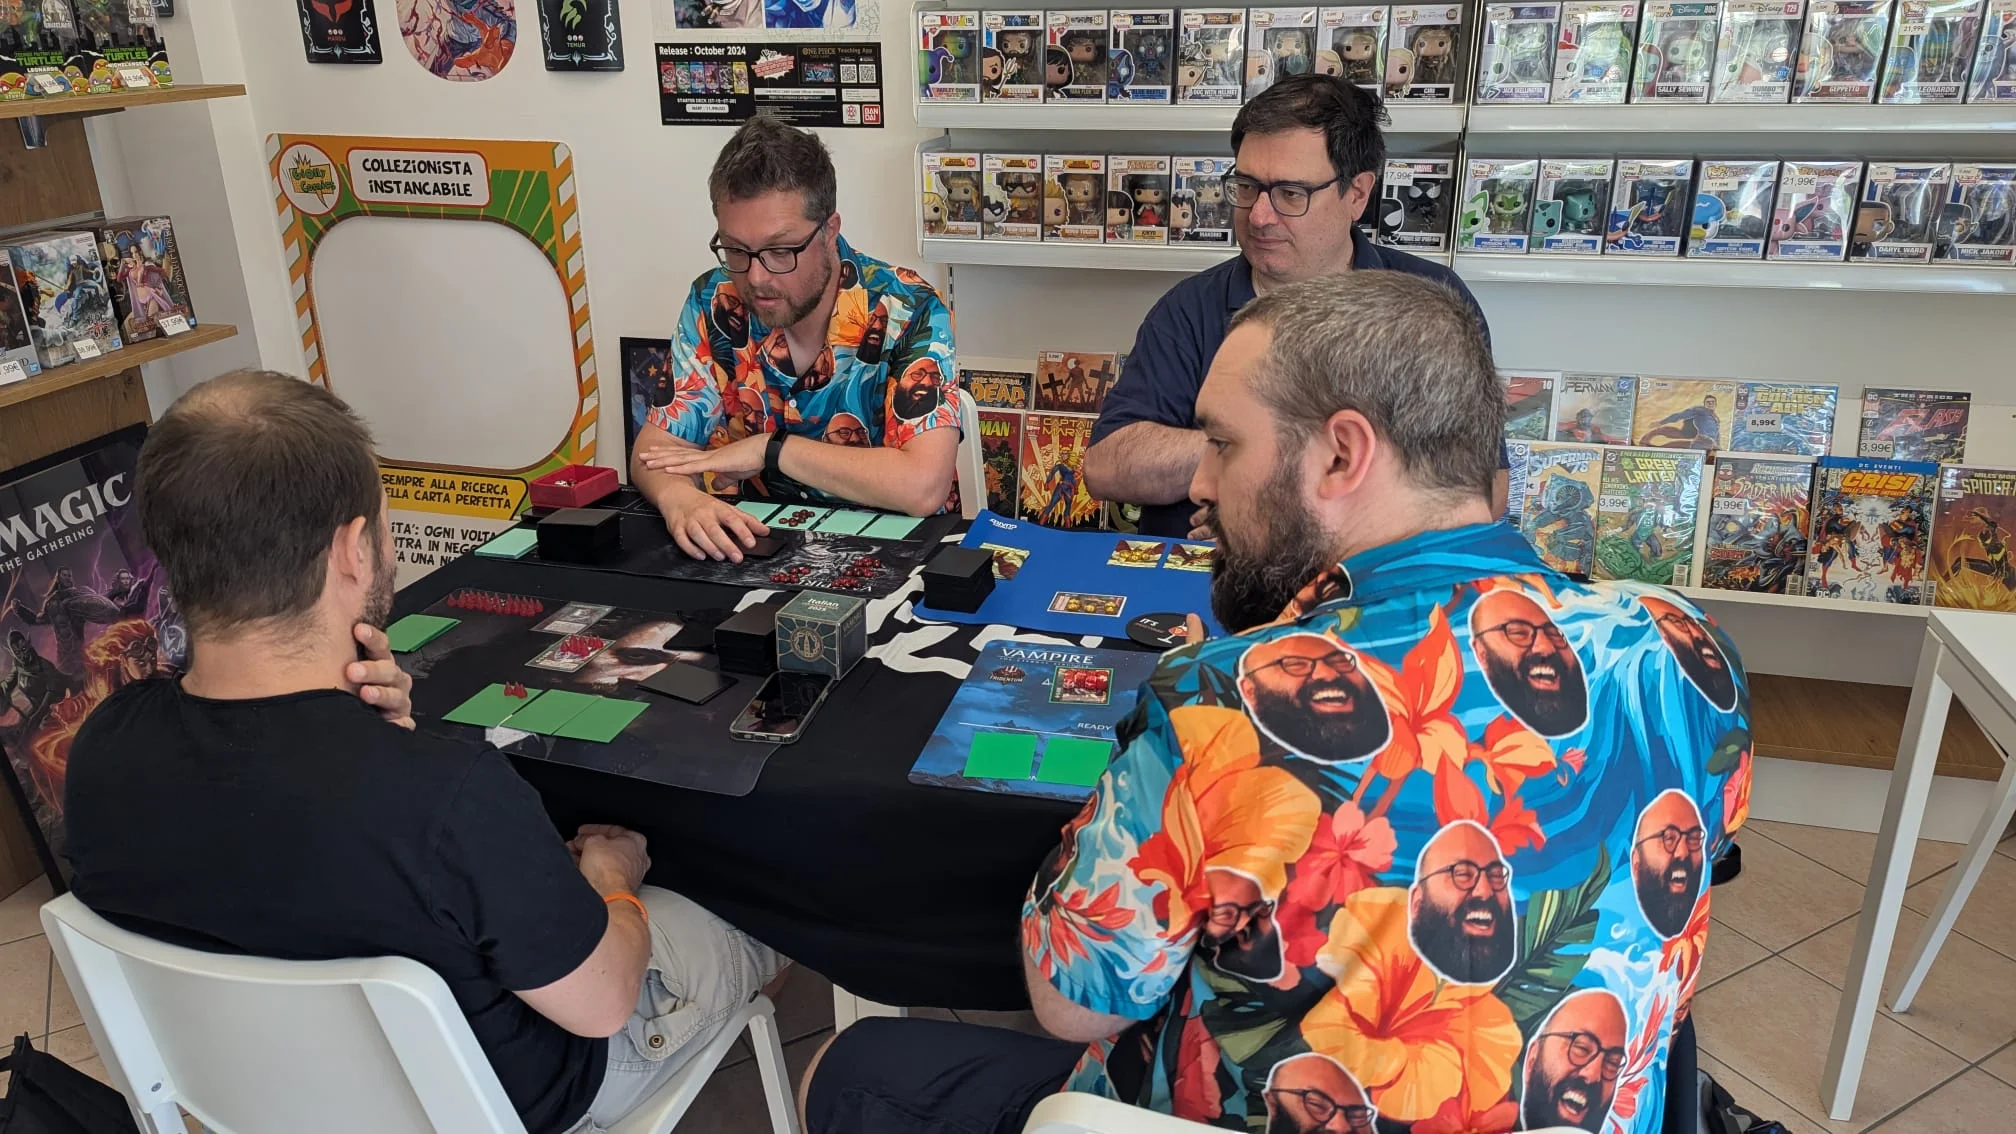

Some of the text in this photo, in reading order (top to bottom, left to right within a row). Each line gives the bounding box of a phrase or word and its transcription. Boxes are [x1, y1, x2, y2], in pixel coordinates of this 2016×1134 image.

[1621, 7, 1634, 15] 72
[1676, 5, 1701, 14] Disney
[1757, 4, 1783, 12] Disney
[659, 46, 688, 55] Release
[694, 46, 725, 55] October
[726, 46, 746, 55] 2024
[17, 55, 64, 66] TURTLES
[105, 51, 148, 61] TURTLES
[1678, 86, 1704, 94] SEWING
[1918, 86, 1955, 94] LEONARDO
[864, 107, 879, 115] BAN
[1385, 171, 1412, 180] 17,99€
[1782, 177, 1816, 187] 21,99€
[1903, 247, 1925, 255] WARD
[1543, 380, 1553, 390] 10
[969, 382, 1025, 404] DEAD
[1043, 418, 1094, 428] CAPTAI
[1751, 419, 1776, 427] 8,99€
[980, 420, 1010, 437] MAN
[1042, 428, 1092, 438] MARVE
[1860, 442, 1892, 453] 3,99€
[1529, 452, 1601, 476] SUPERMAN
[381, 473, 425, 488] SEMPRE
[430, 478, 456, 490] ALLA
[1842, 472, 1918, 490] CRISI
[1732, 476, 1810, 500] SPIDER-MAN
[385, 487, 511, 509] ELLA CARTA PERFETTA
[1600, 499, 1628, 508] 3,99€
[1714, 500, 1745, 510] 3,99€
[0, 472, 132, 558] MAGIC
[424, 525, 455, 539] OGNI
[0, 525, 94, 574] THE GATHERING
[428, 539, 440, 552] IN
[410, 552, 435, 565] UNA
[1816, 590, 1831, 599] DC
[807, 598, 839, 607] Italian
[1001, 648, 1095, 665] VAMPIRE
[989, 674, 1024, 683] TRIDENTUM
[1077, 722, 1113, 731] READY
